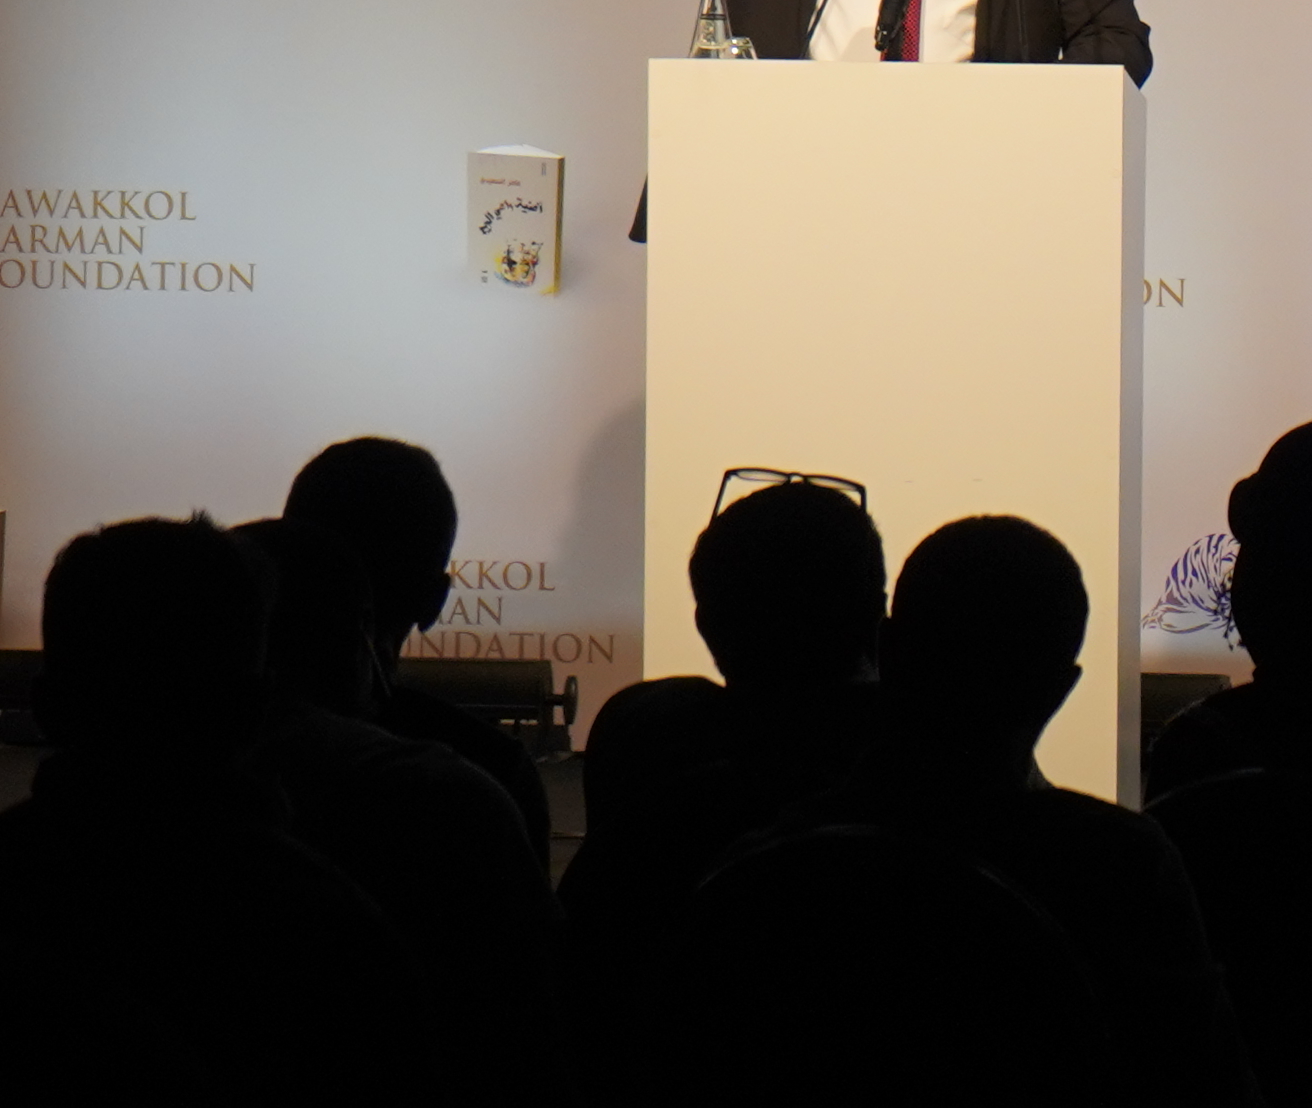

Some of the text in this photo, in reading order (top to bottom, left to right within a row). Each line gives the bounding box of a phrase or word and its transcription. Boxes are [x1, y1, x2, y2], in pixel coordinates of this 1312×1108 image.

[0, 188, 197, 222] AWAKKOL
[0, 224, 145, 255] ARMAN
[0, 258, 256, 293] OUNDATION
[405, 631, 615, 665] NDATION
